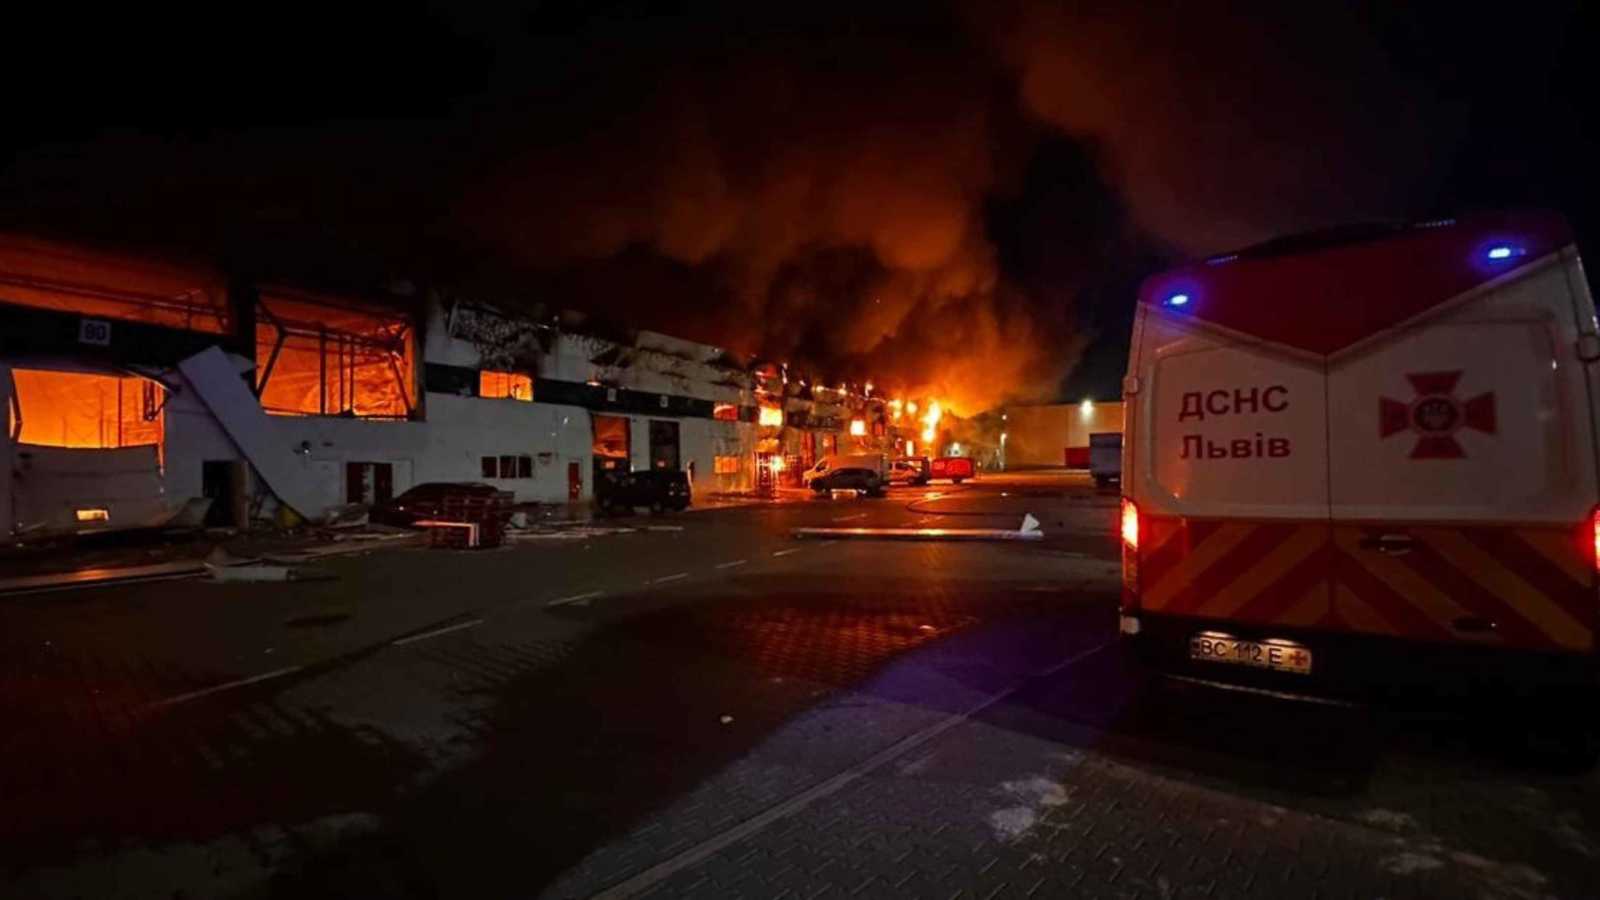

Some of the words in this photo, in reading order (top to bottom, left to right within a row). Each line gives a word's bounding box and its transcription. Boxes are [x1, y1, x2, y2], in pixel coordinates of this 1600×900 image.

[1178, 386, 1289, 421] ДСНС
[1179, 432, 1291, 459] Львів
[1232, 641, 1262, 662] 112
